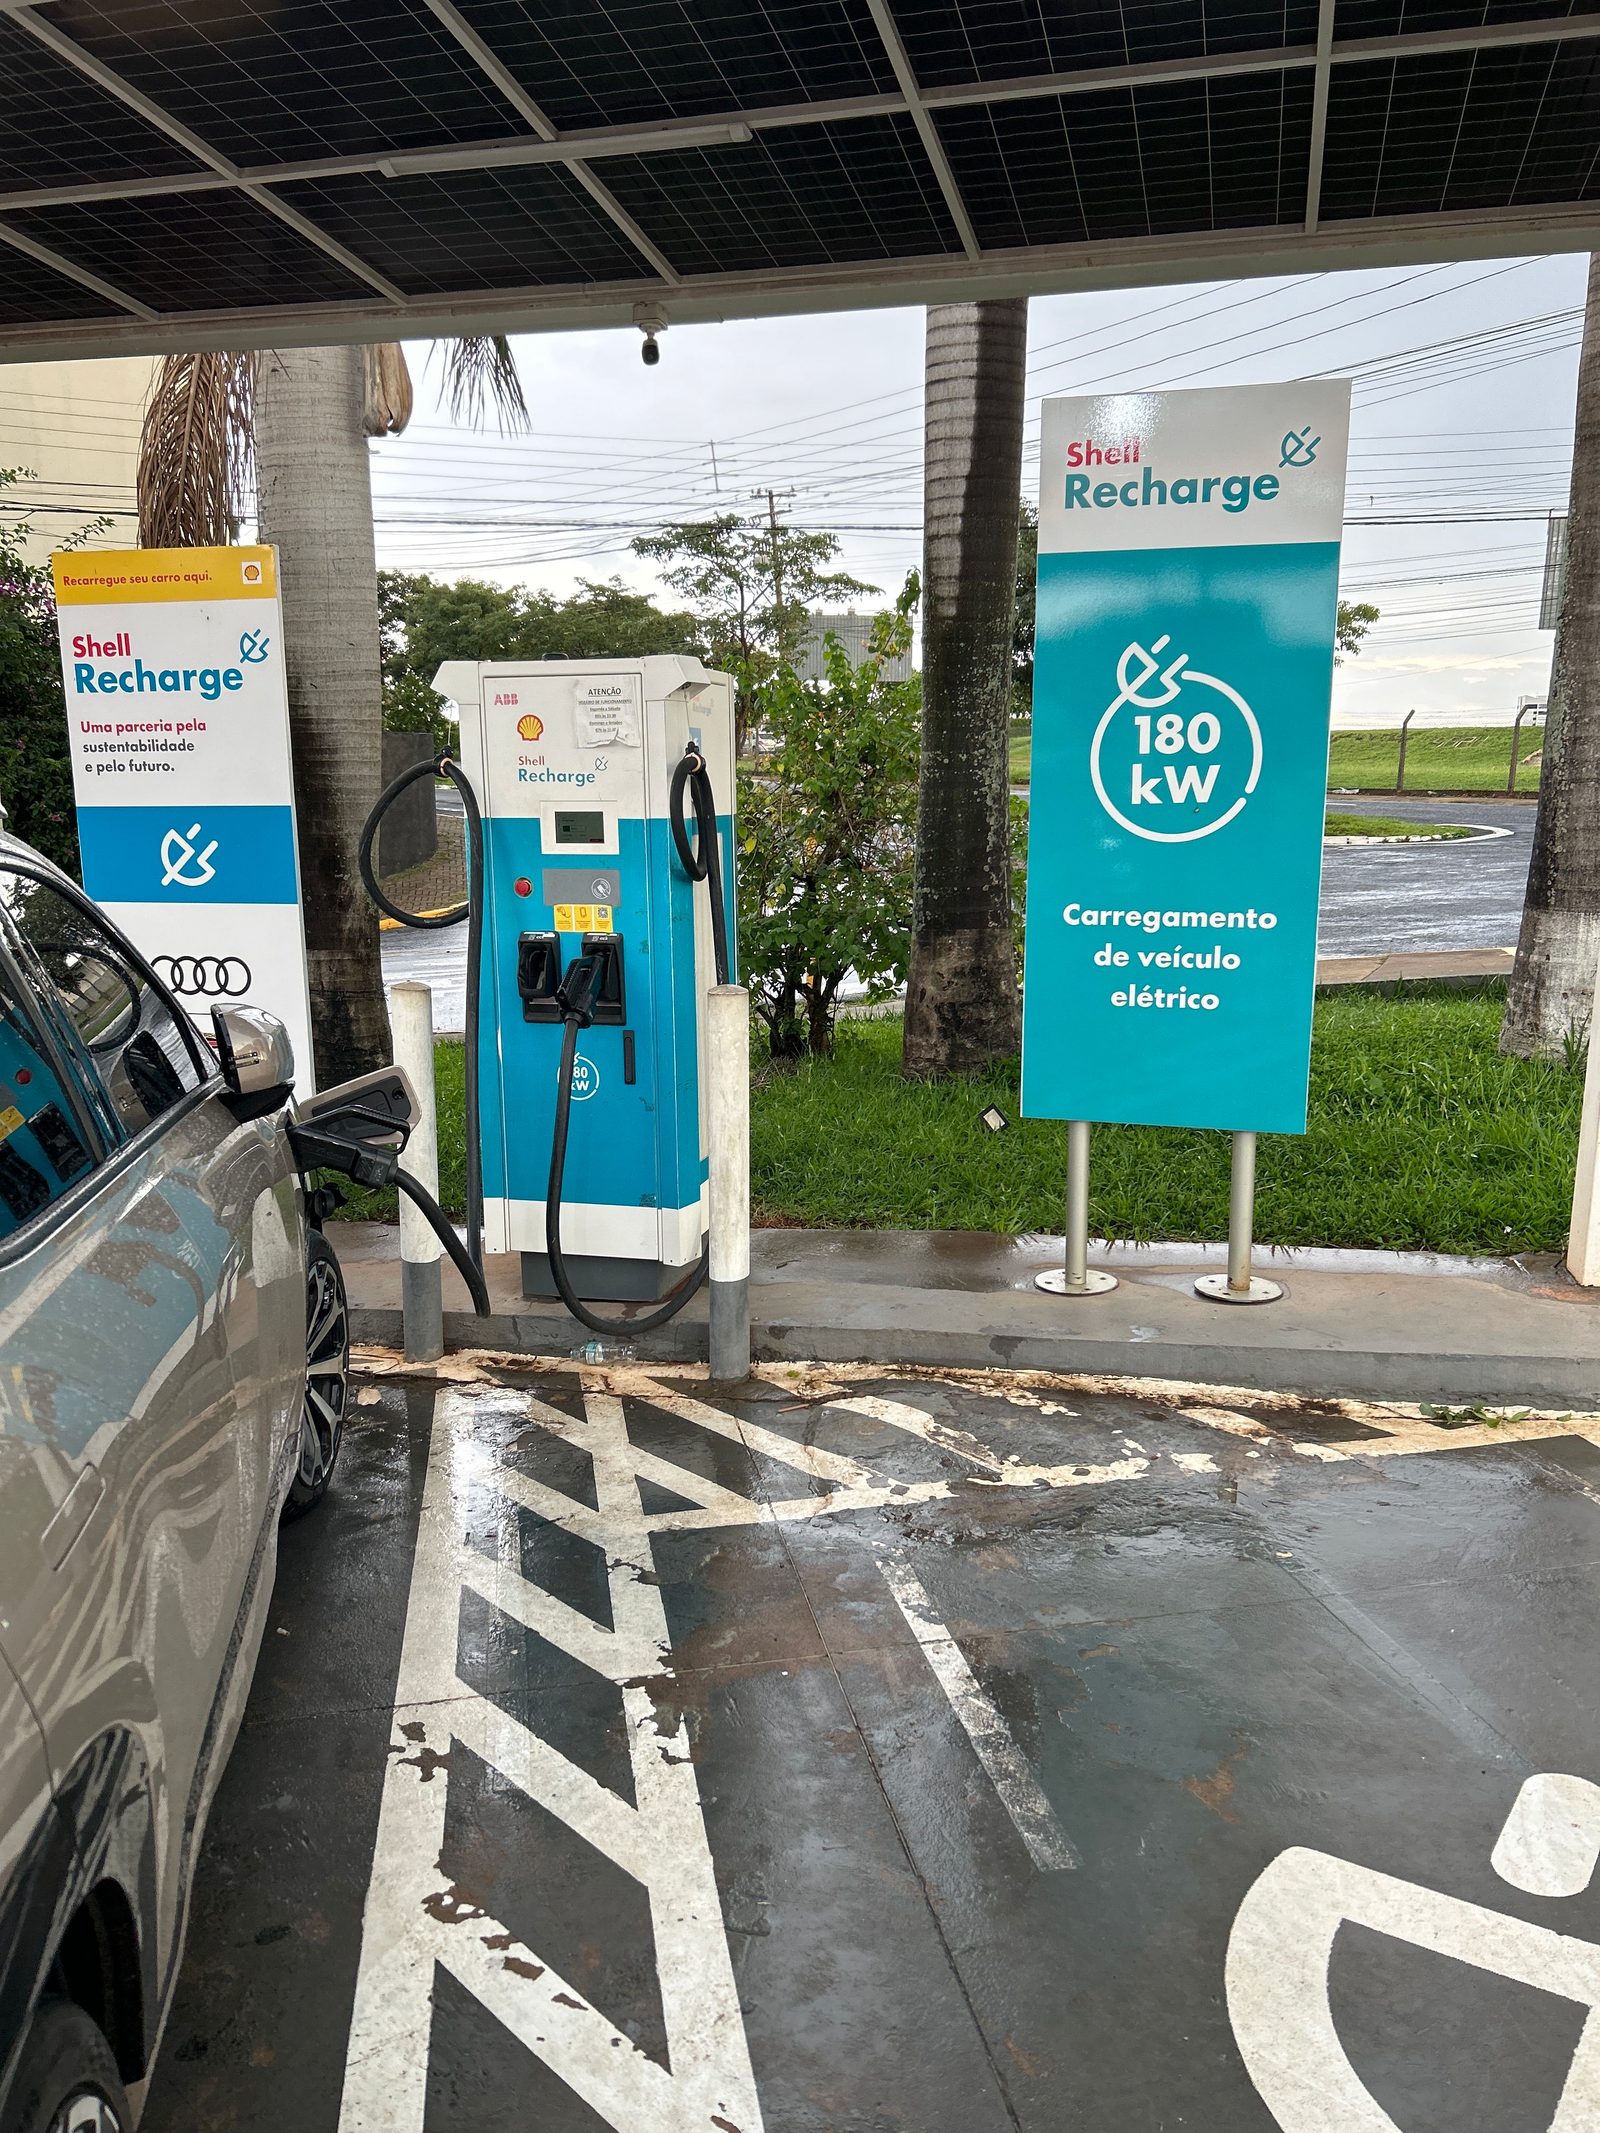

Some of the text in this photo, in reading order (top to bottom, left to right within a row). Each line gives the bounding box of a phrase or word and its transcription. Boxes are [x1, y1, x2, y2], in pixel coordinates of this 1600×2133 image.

[1066, 436, 1141, 468] Shell
[1065, 467, 1280, 513] Recharge
[63, 570, 213, 587] Recarregue seu carro aqui.
[72, 633, 131, 658] Shell
[74, 659, 243, 701] Recharge
[494, 693, 519, 706] ABB
[588, 686, 622, 697] ATENÇÃO
[80, 718, 206, 736] Uma parceria pela
[1134, 712, 1221, 754] 180
[83, 738, 195, 753] sustentabilidade
[85, 759, 175, 775] e pelo futuro.
[518, 755, 545, 766] Shell
[518, 767, 596, 787] Recharge
[1131, 763, 1221, 804] kW
[1062, 903, 1278, 933] Carregamento
[1093, 943, 1241, 970] de veículo
[1111, 983, 1220, 1010] elétrico
[573, 1066, 588, 1079] 80
